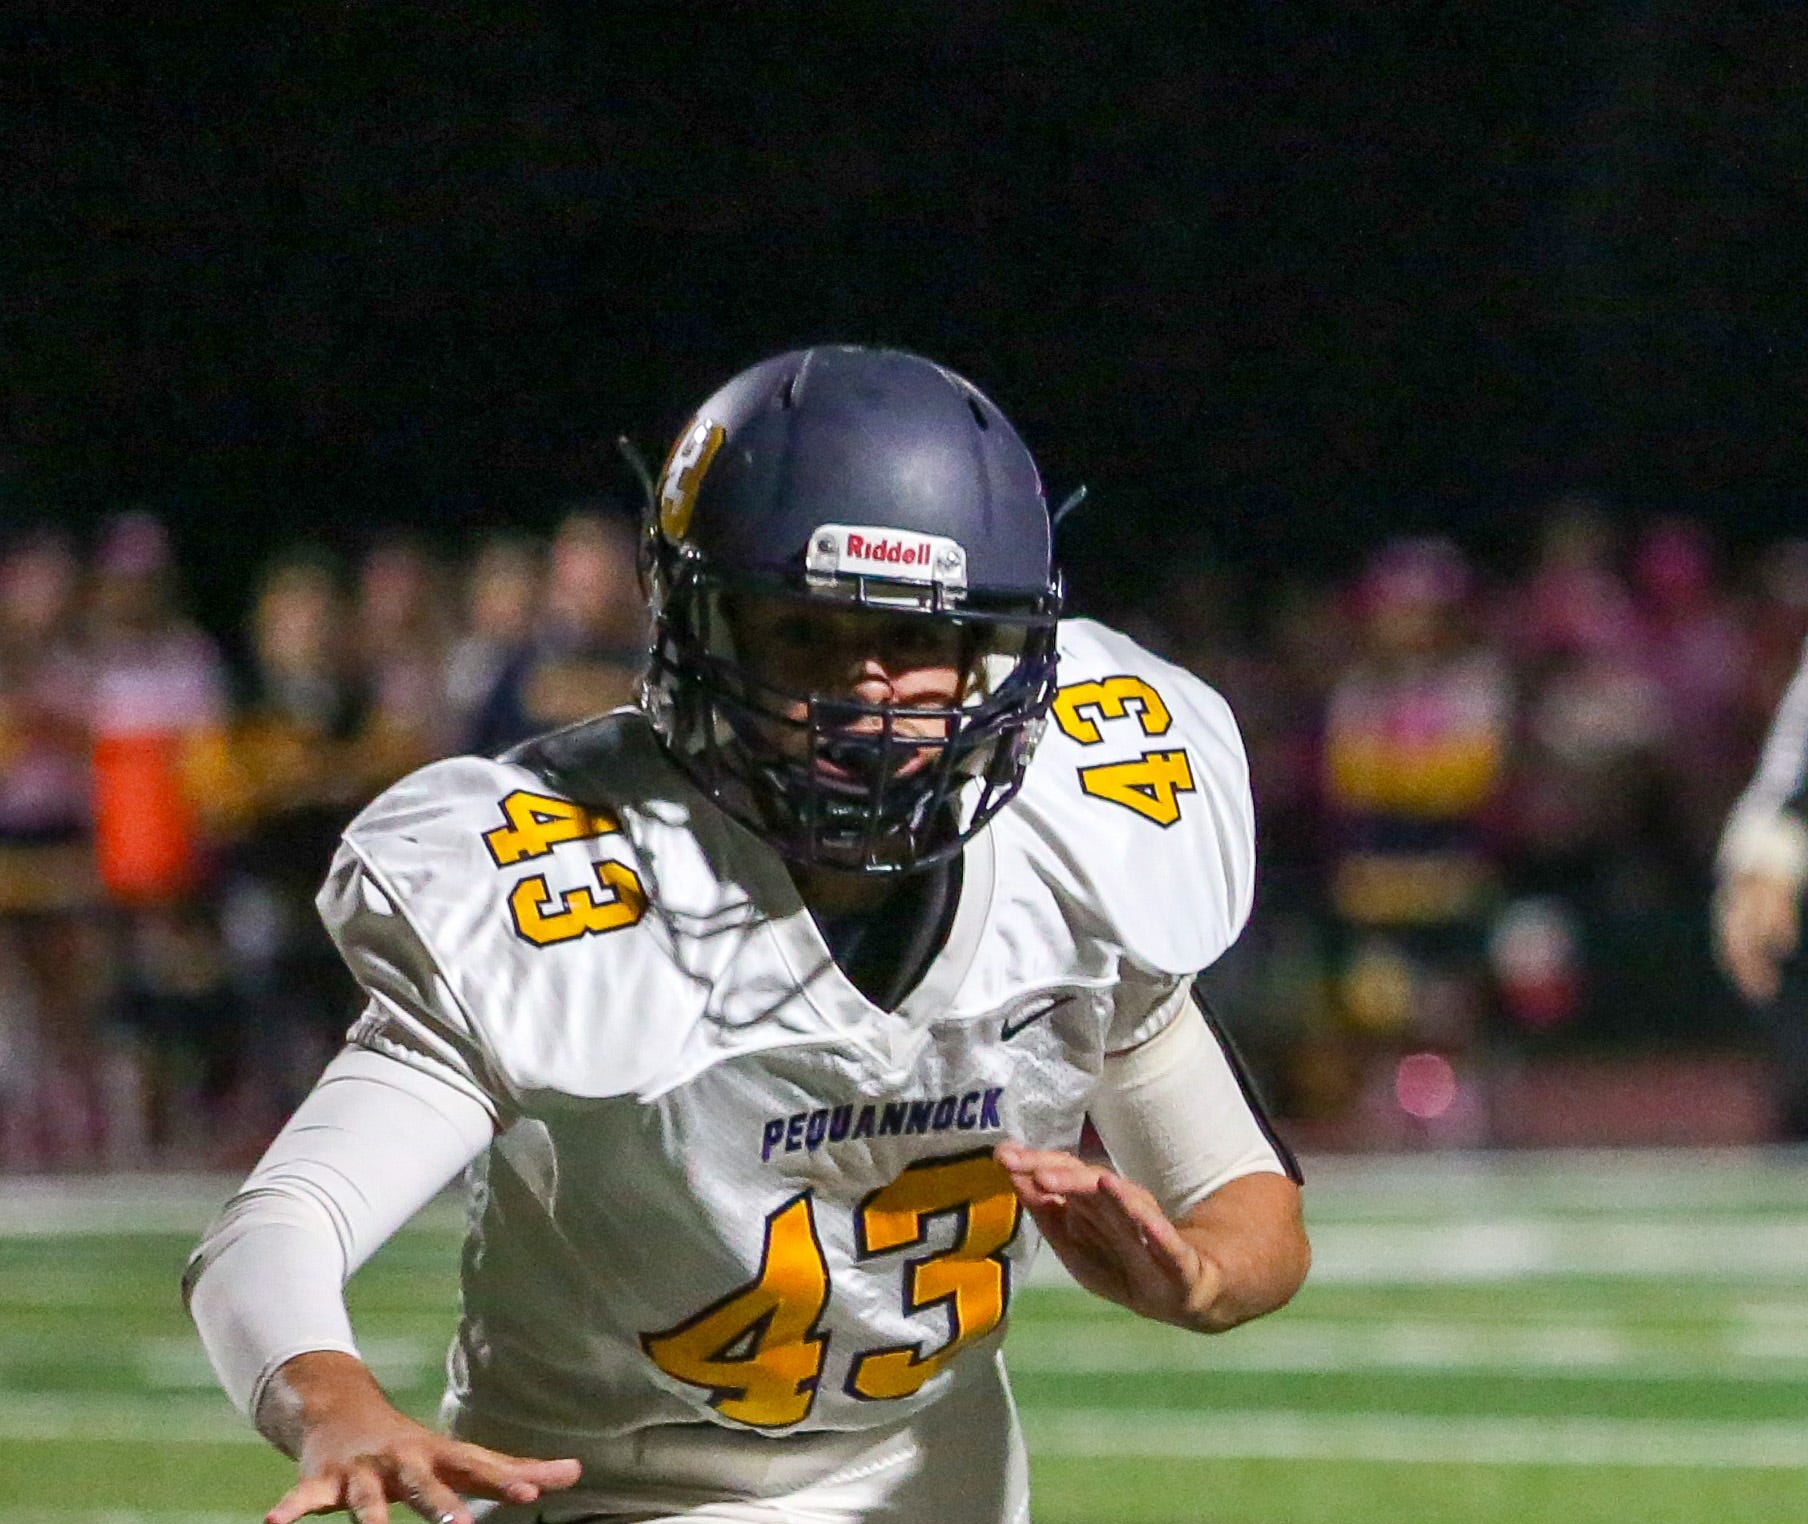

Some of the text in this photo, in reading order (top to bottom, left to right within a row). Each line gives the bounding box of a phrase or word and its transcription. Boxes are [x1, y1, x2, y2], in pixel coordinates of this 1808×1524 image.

[847, 533, 931, 566] Riddell
[1050, 675, 1197, 829] 43
[481, 789, 650, 948] 43
[762, 1087, 1003, 1162] PEQUANNOCK
[639, 1147, 1020, 1428] 43
